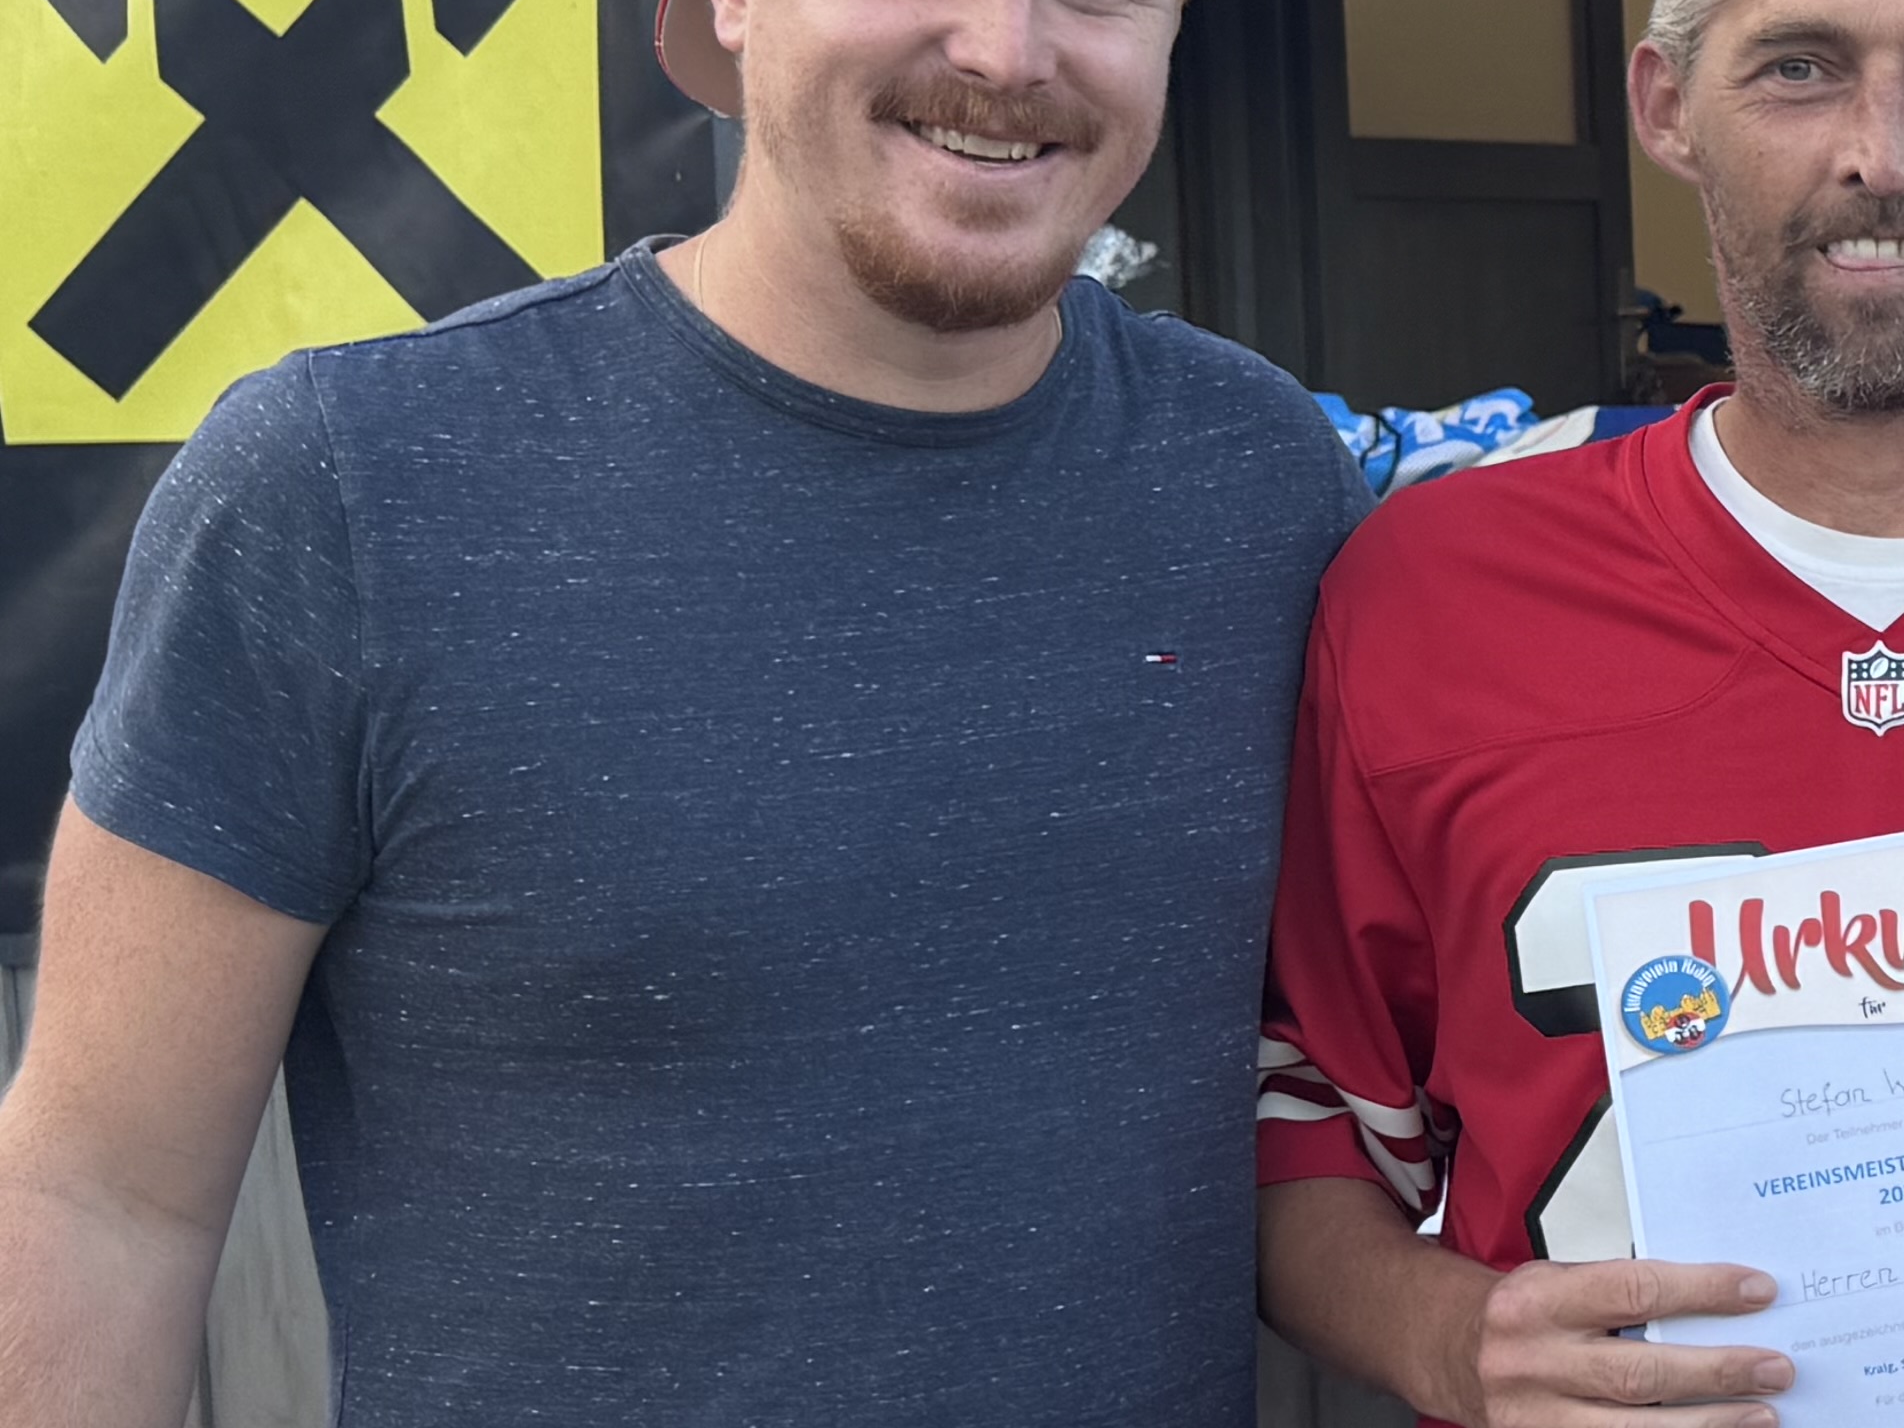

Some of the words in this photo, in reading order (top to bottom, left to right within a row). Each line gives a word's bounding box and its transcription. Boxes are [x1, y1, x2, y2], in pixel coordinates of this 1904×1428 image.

[1854, 683, 1904, 720] NFL
[1781, 1081, 1871, 1118] Stefan
[1833, 1117, 1904, 1140] Teilnehmer
[1800, 1265, 1899, 1302] Herren
